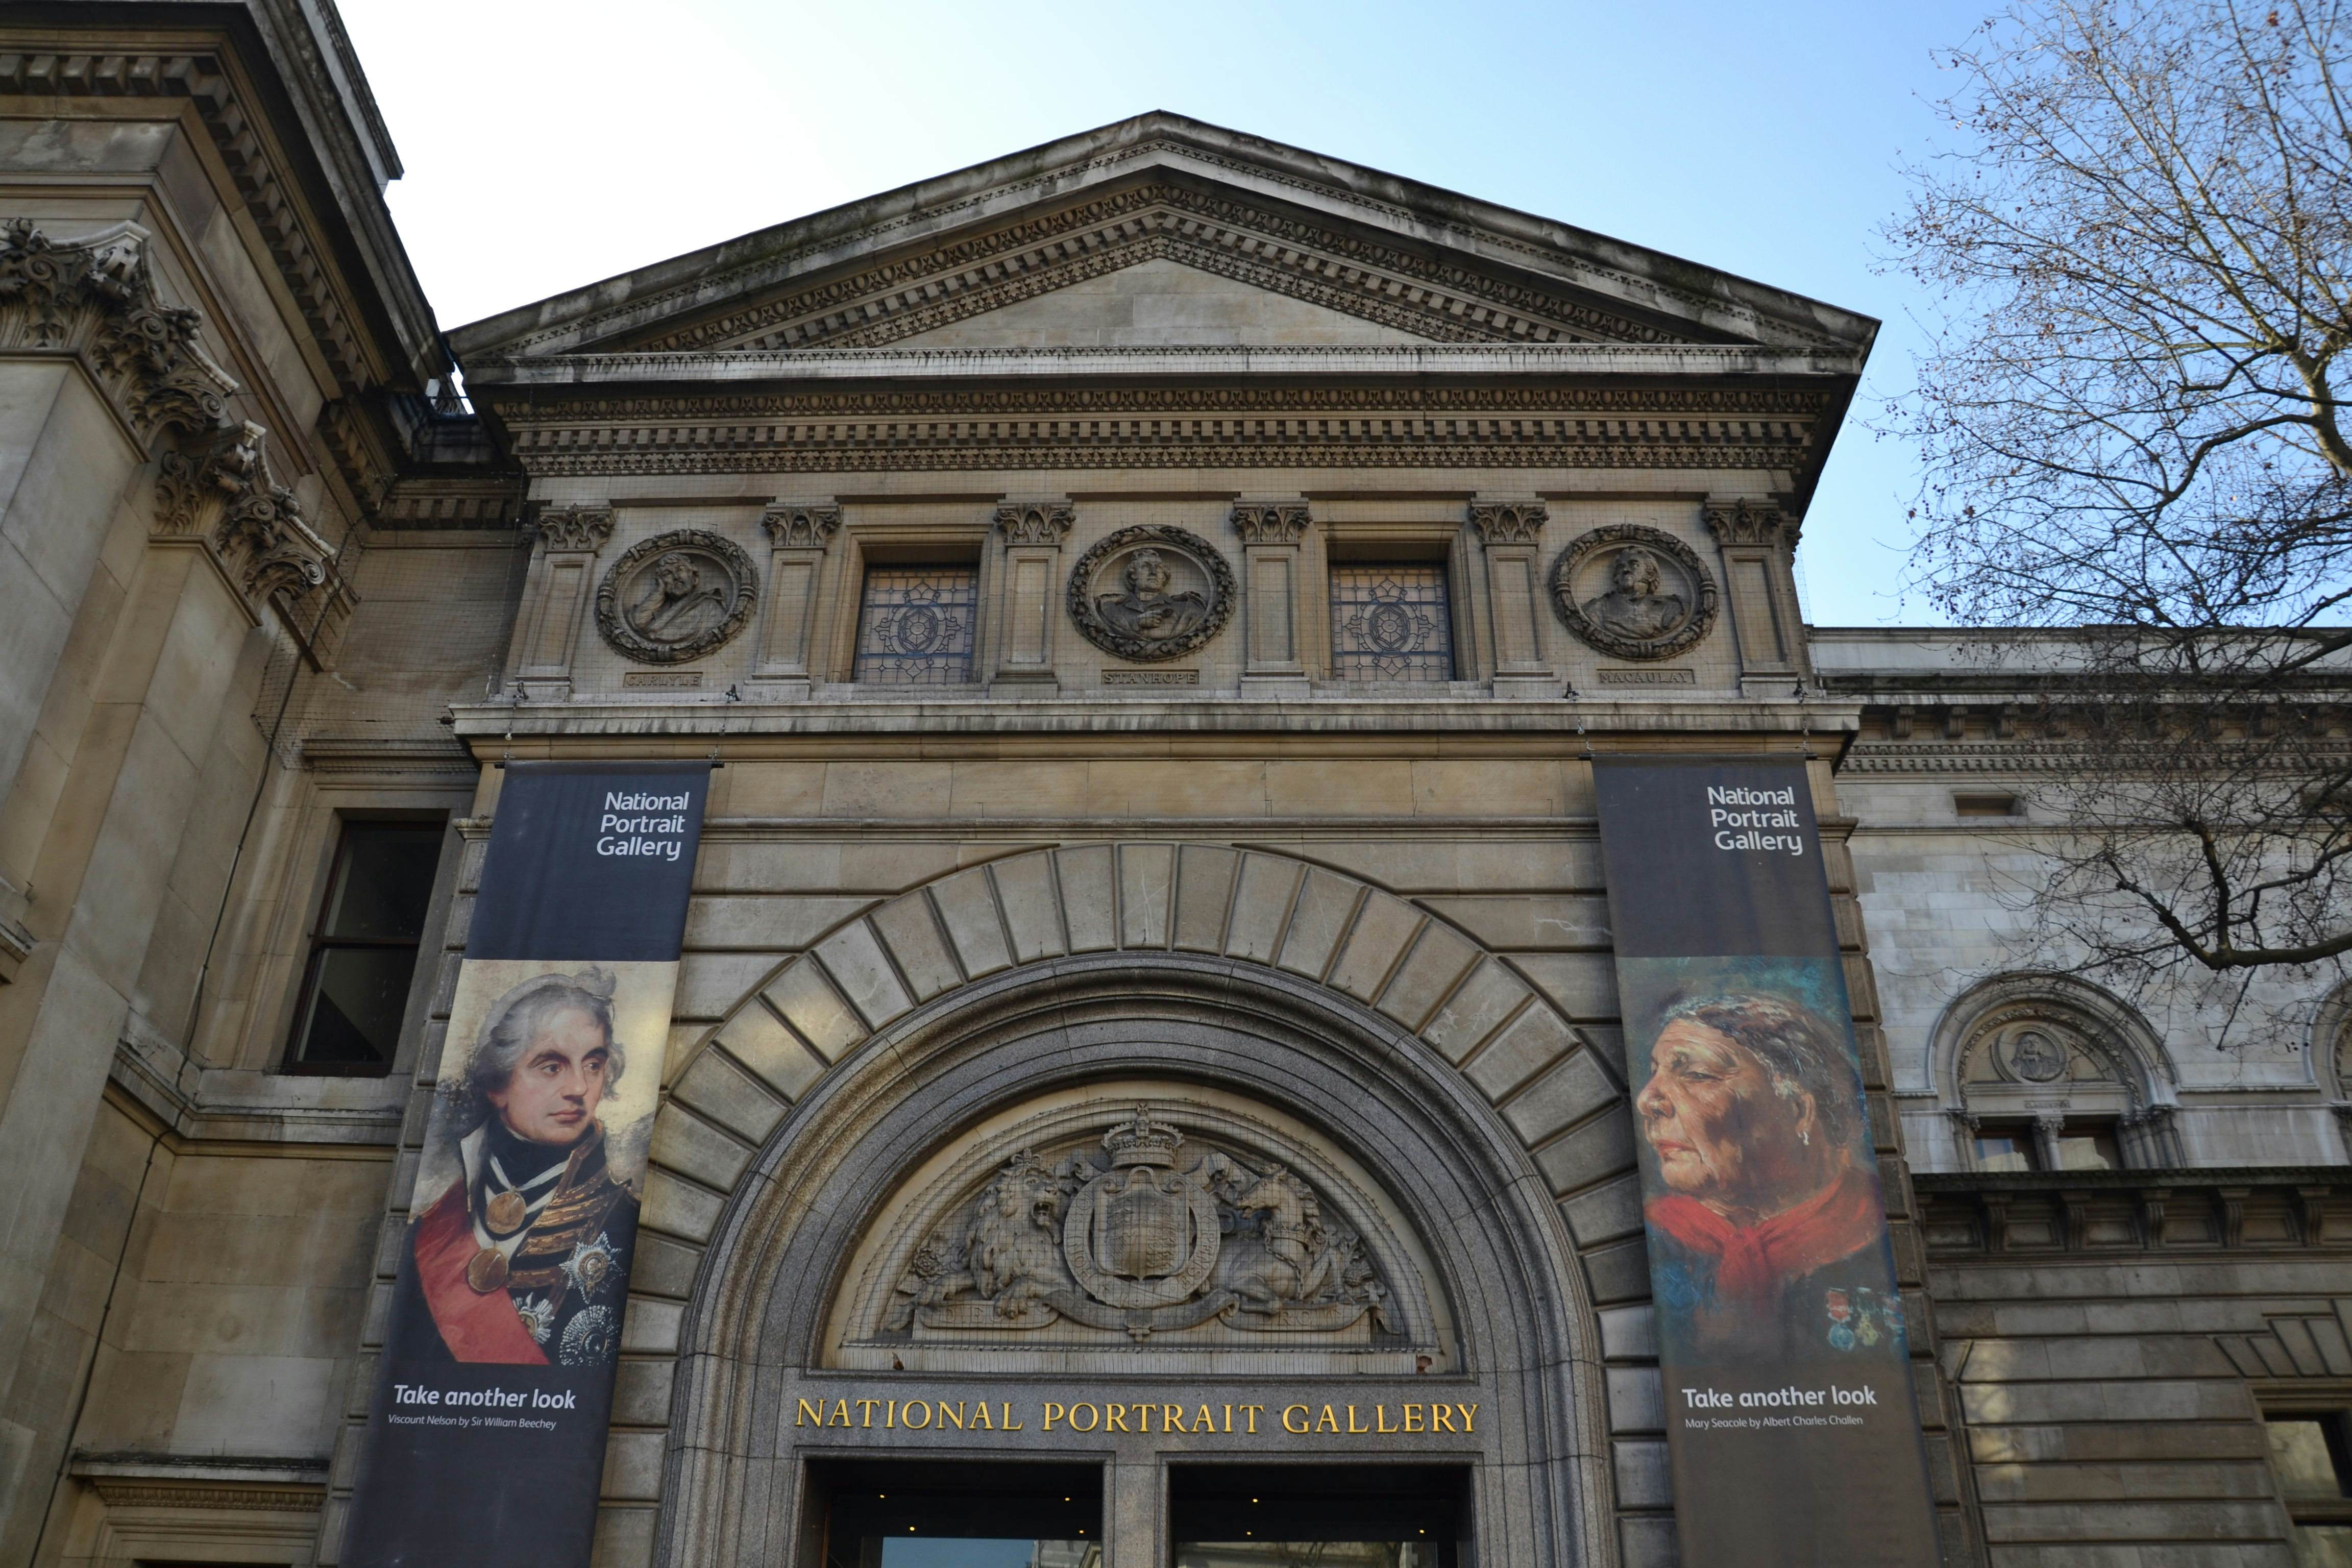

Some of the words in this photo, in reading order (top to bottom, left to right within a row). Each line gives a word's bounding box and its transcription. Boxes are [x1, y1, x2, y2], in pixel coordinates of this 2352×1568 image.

[627, 675, 700, 686] CARLYLE
[1104, 673, 1196, 684] STANHOPE
[1599, 672, 1689, 683] MACAULAY
[604, 792, 689, 811] National
[1707, 786, 1795, 805] National
[600, 814, 685, 833] Portrait
[1711, 808, 1800, 827] Portrait
[597, 836, 681, 862] Gallery
[1714, 830, 1803, 856] Gallery
[394, 1384, 439, 1405] Take
[445, 1387, 527, 1407] another
[532, 1388, 576, 1409] look
[1681, 1388, 1733, 1408] Take
[1739, 1386, 1826, 1407] another
[1831, 1385, 1877, 1405] look
[388, 1414, 425, 1424] Viscount
[427, 1416, 457, 1426] Nelson
[459, 1416, 470, 1428] by
[472, 1417, 482, 1426] Sir
[484, 1417, 517, 1427] William
[519, 1418, 557, 1431] Beechey
[795, 1398, 1023, 1430] NATIONAL
[1042, 1402, 1264, 1433] PORTRAIT
[1282, 1403, 1479, 1433] GALLERY
[1685, 1418, 1709, 1430] Mary
[1711, 1417, 1748, 1428] Seacole
[1749, 1417, 1760, 1429] by
[1763, 1416, 1791, 1427] Albert
[1793, 1415, 1827, 1426] Charles
[1829, 1415, 1864, 1425] Challen
